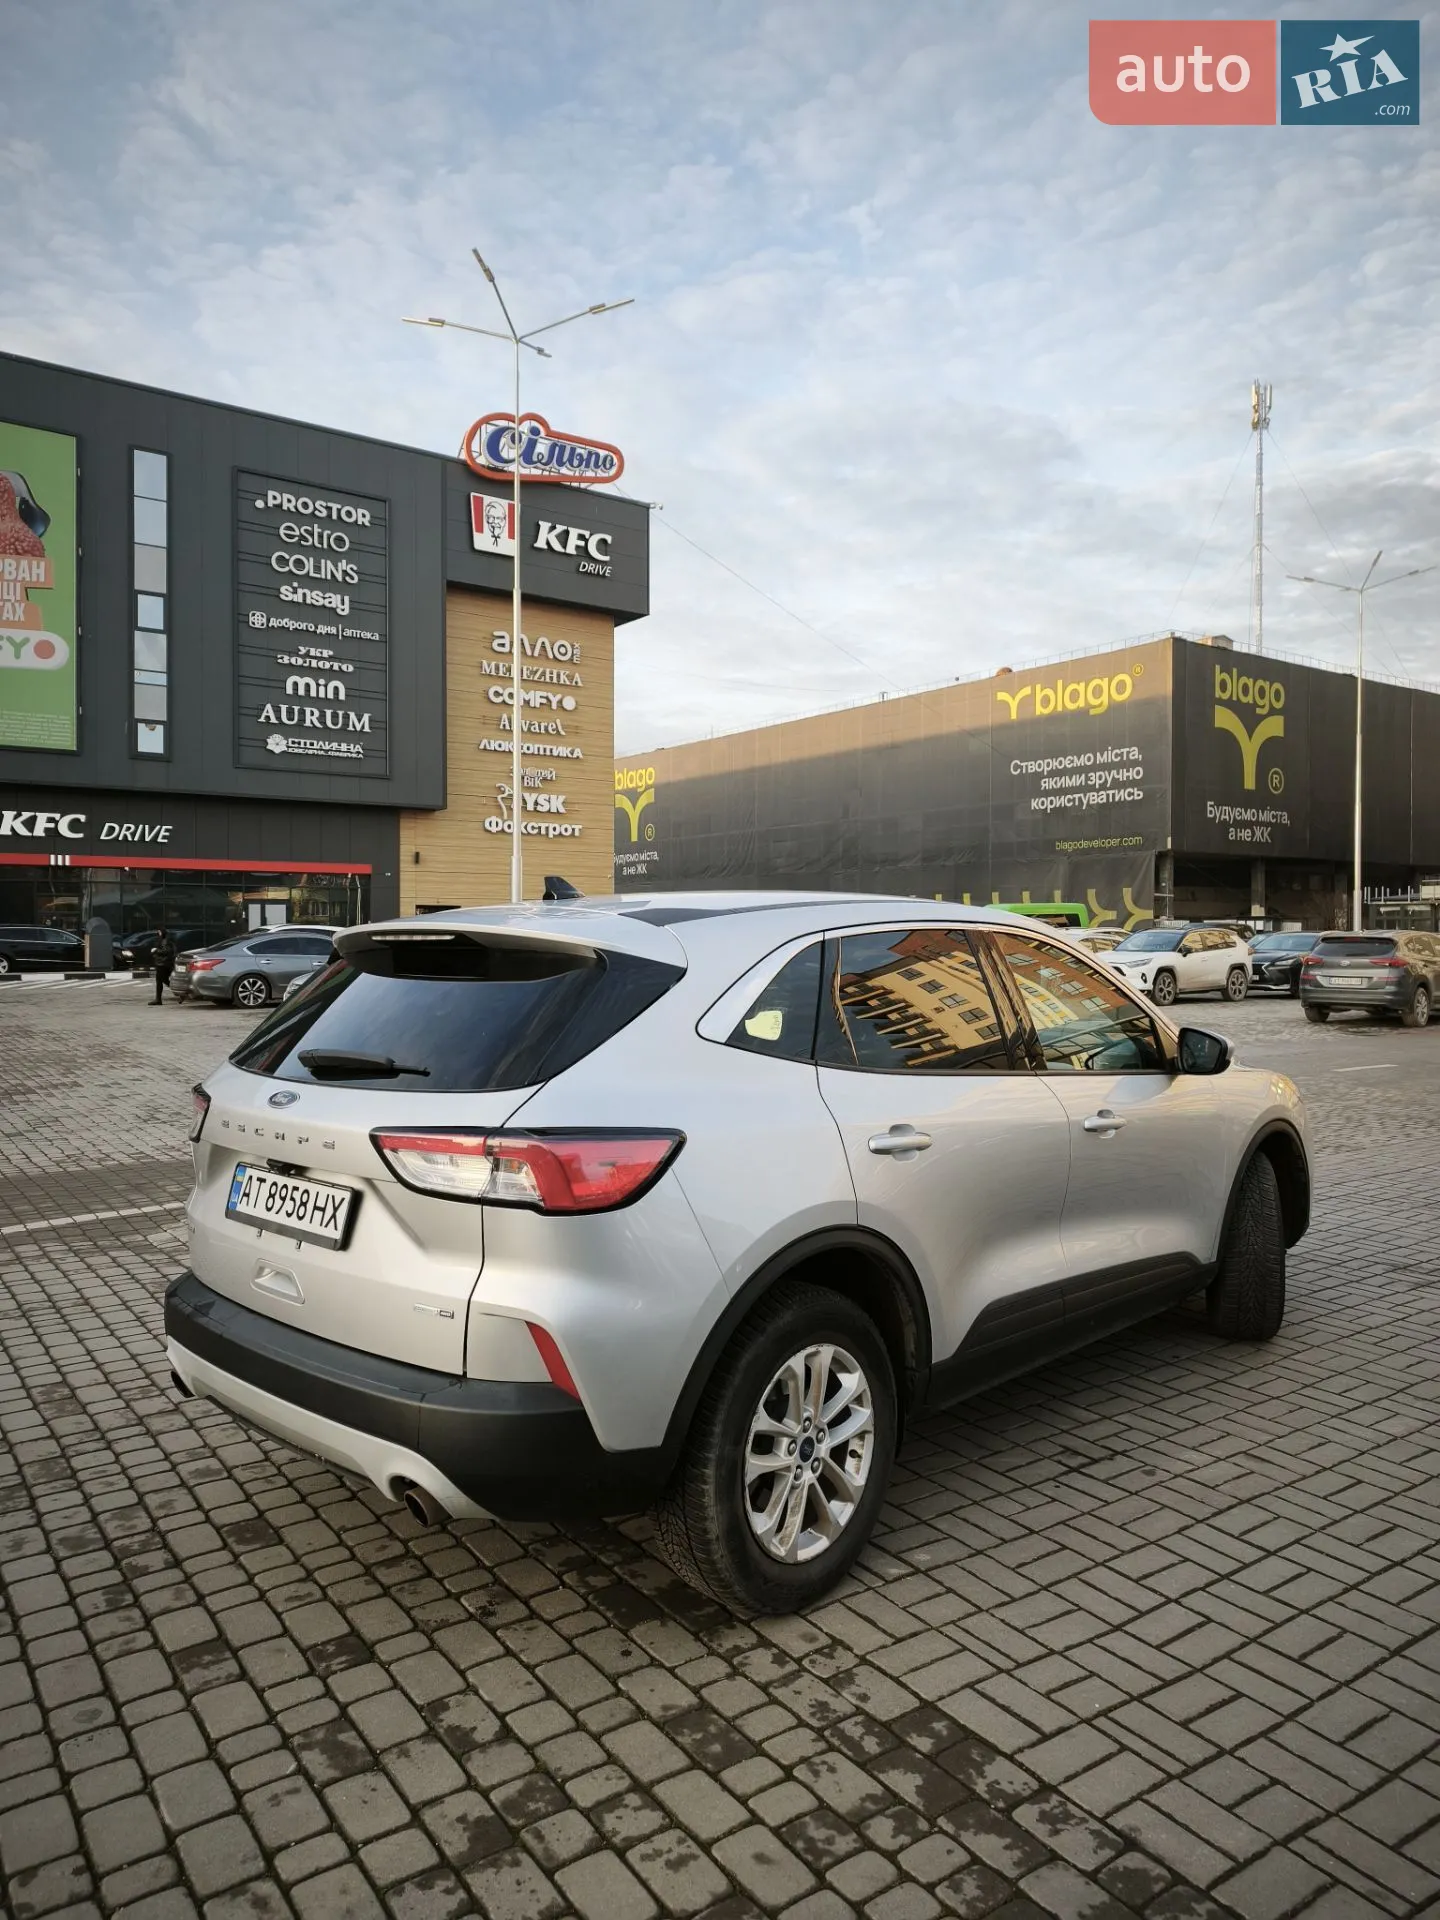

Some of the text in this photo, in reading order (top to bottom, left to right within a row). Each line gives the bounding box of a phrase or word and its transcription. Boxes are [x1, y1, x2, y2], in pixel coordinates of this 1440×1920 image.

[483, 425, 617, 474] Сільпо
[279, 522, 350, 552] estro
[533, 520, 613, 562] KFC
[0, 558, 45, 582] ВАН
[271, 551, 359, 584] COLIN'S
[579, 561, 613, 577] DRIVE
[279, 582, 350, 616] sinsay
[269, 617, 379, 641] доброго дня аптека
[277, 655, 354, 672] ЗОЛОТО
[298, 646, 334, 657] УКР
[286, 675, 346, 700] min
[1035, 673, 1133, 716] blago
[1215, 664, 1285, 715] blago
[257, 703, 372, 732] AURUM
[288, 738, 363, 753] СТОЛИЧНА
[1010, 746, 1142, 775] Створюємо міста,
[614, 767, 655, 792] blago
[1041, 766, 1143, 791] якими зручно
[511, 793, 567, 813] YSK
[1031, 787, 1143, 813] користуватись
[0, 810, 86, 839] KFC
[1207, 801, 1290, 826] Будуємо міста,
[100, 822, 173, 843] DRIVE
[1055, 835, 1143, 852] blagodeveloper.com
[1237, 828, 1251, 842] не
[1252, 826, 1271, 843] ЖК
